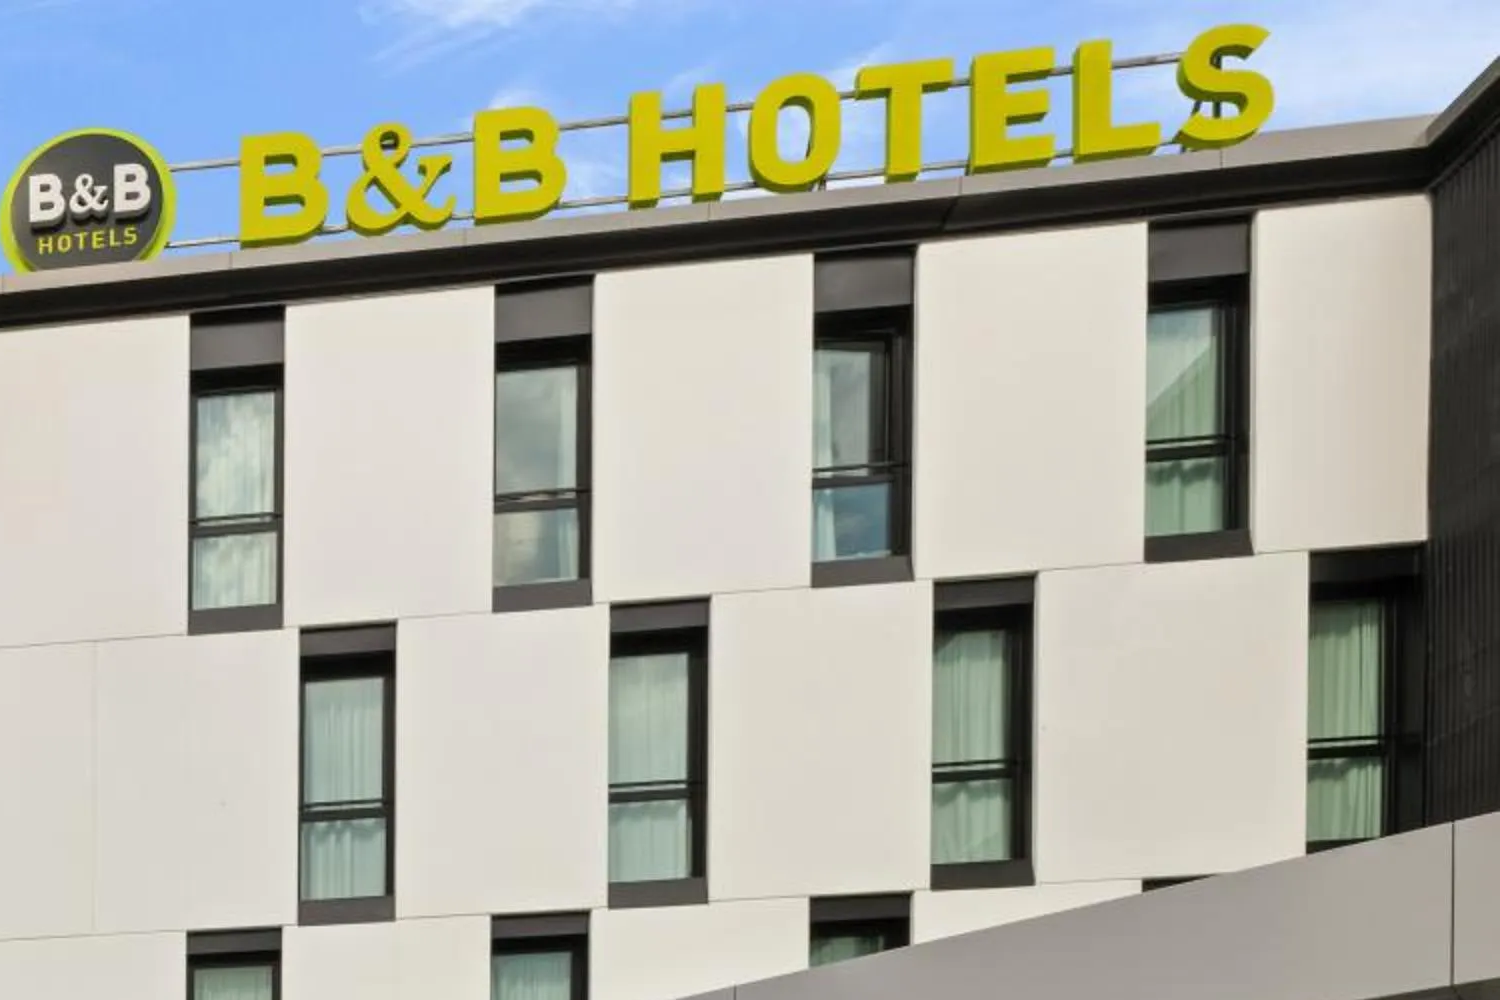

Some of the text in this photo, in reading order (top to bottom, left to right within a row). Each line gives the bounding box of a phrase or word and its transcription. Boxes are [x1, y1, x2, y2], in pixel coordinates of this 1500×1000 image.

[239, 23, 1275, 249] B&B HOTELS
[28, 163, 151, 227] B&B
[38, 226, 138, 255] HOTELS
